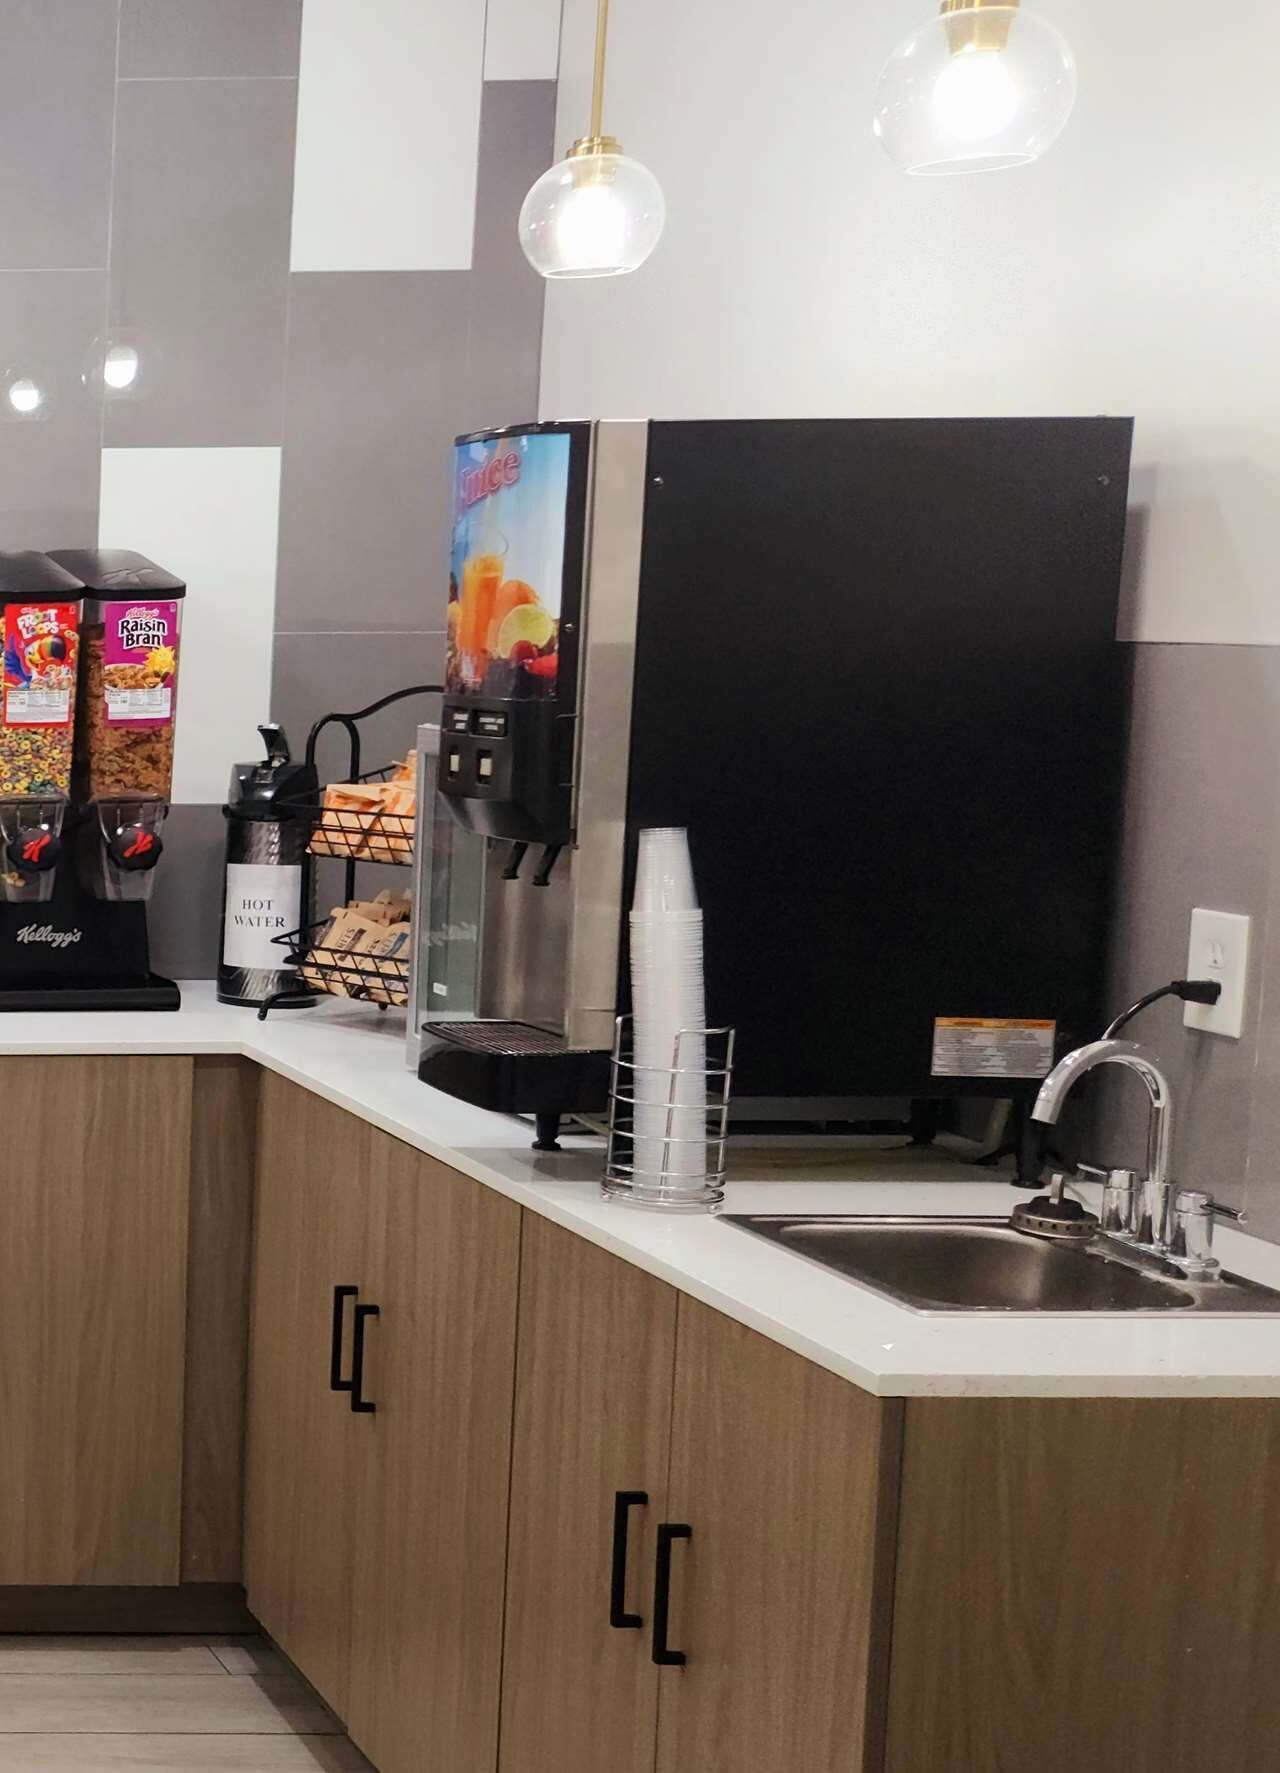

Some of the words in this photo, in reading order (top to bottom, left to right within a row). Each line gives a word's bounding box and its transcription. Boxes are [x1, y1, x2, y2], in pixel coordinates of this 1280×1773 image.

[120, 618, 166, 635] Raisin
[125, 632, 161, 647] Bran
[242, 899, 274, 911] HOT
[234, 914, 286, 928] WATER
[17, 923, 82, 948] Kellogg's
